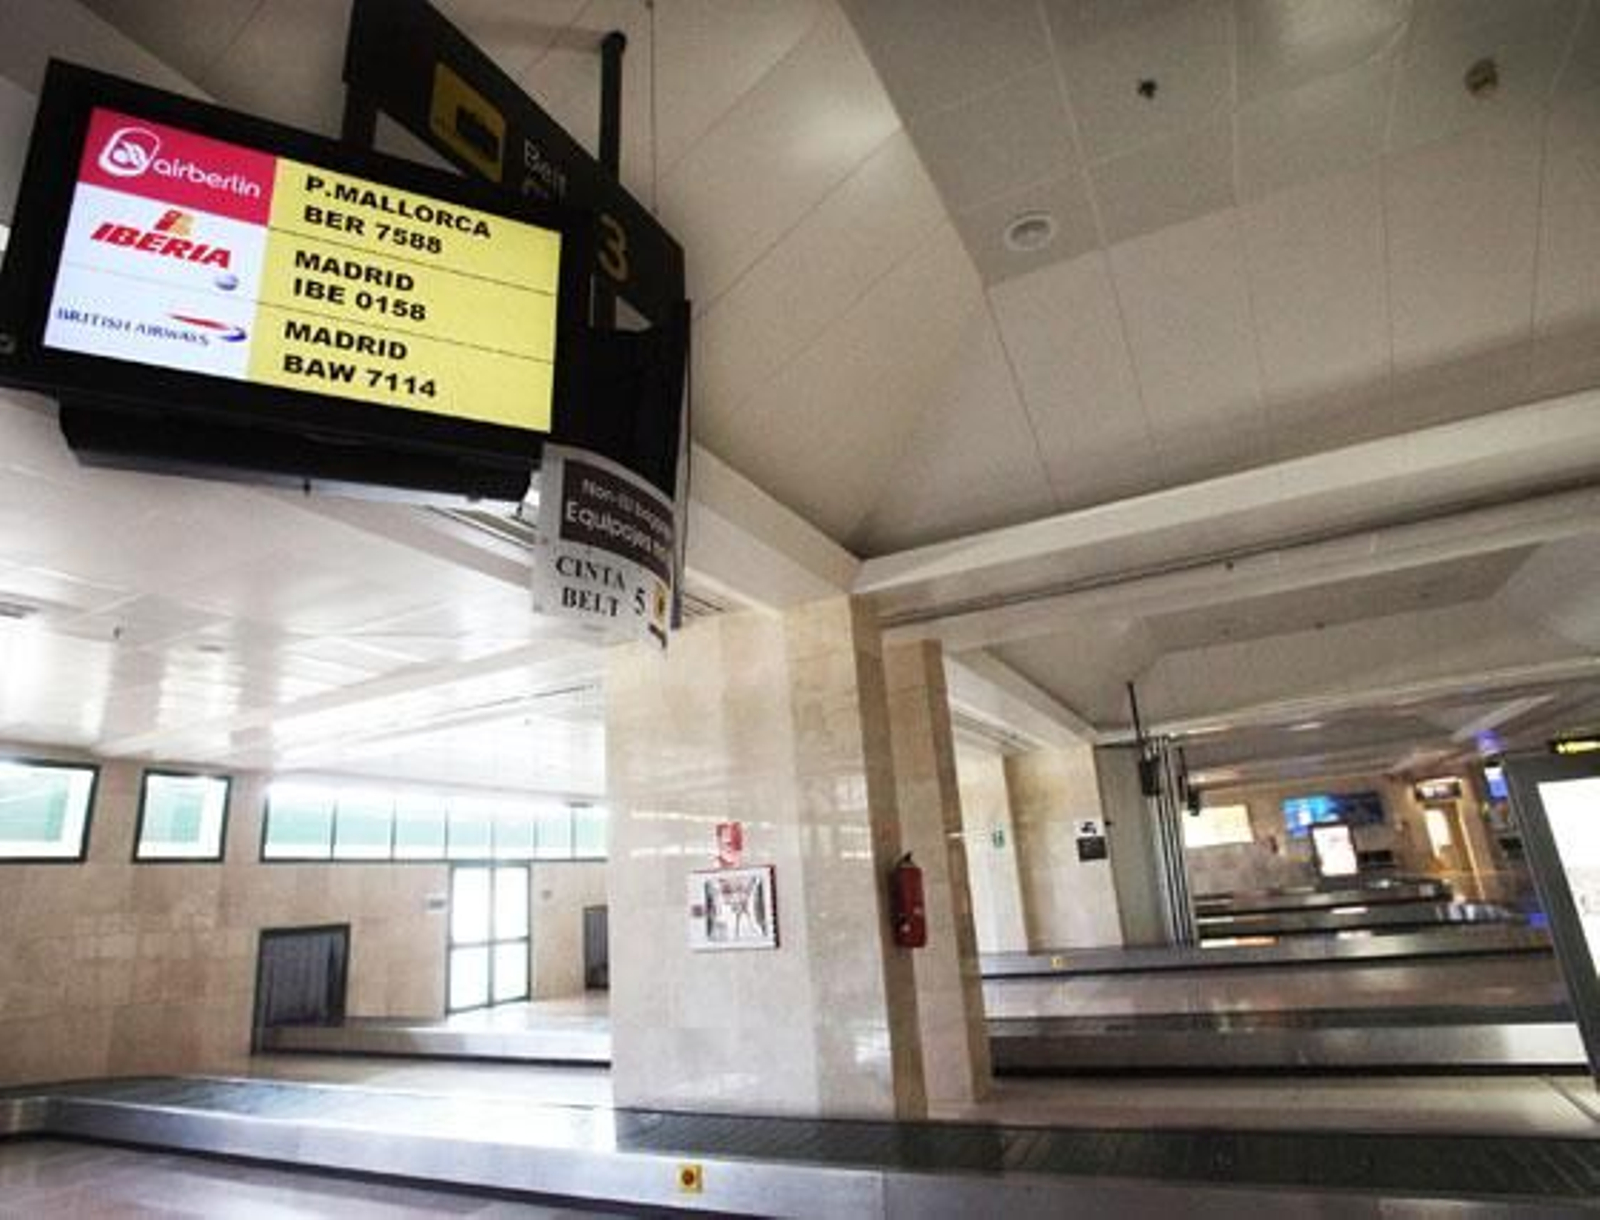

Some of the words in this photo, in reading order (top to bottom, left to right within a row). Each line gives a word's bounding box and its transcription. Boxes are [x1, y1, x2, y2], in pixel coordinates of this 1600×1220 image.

[152, 157, 261, 199] airberlin
[305, 174, 492, 239] P.MALLORCA
[90, 221, 232, 270] IBERIA
[303, 204, 365, 236] BER
[375, 222, 443, 254] 7588
[598, 211, 630, 282] 3
[294, 249, 415, 293] MADRID
[293, 276, 346, 306] IBE
[355, 290, 427, 322] 0158
[56, 306, 132, 332] BRITISH
[134, 322, 211, 347] AIRWAYS
[284, 319, 408, 361] MADRID
[282, 353, 357, 384] BAW
[366, 368, 437, 399] 7114
[555, 554, 626, 592] CINTA
[561, 585, 620, 617] BELT
[632, 587, 647, 617] 5
